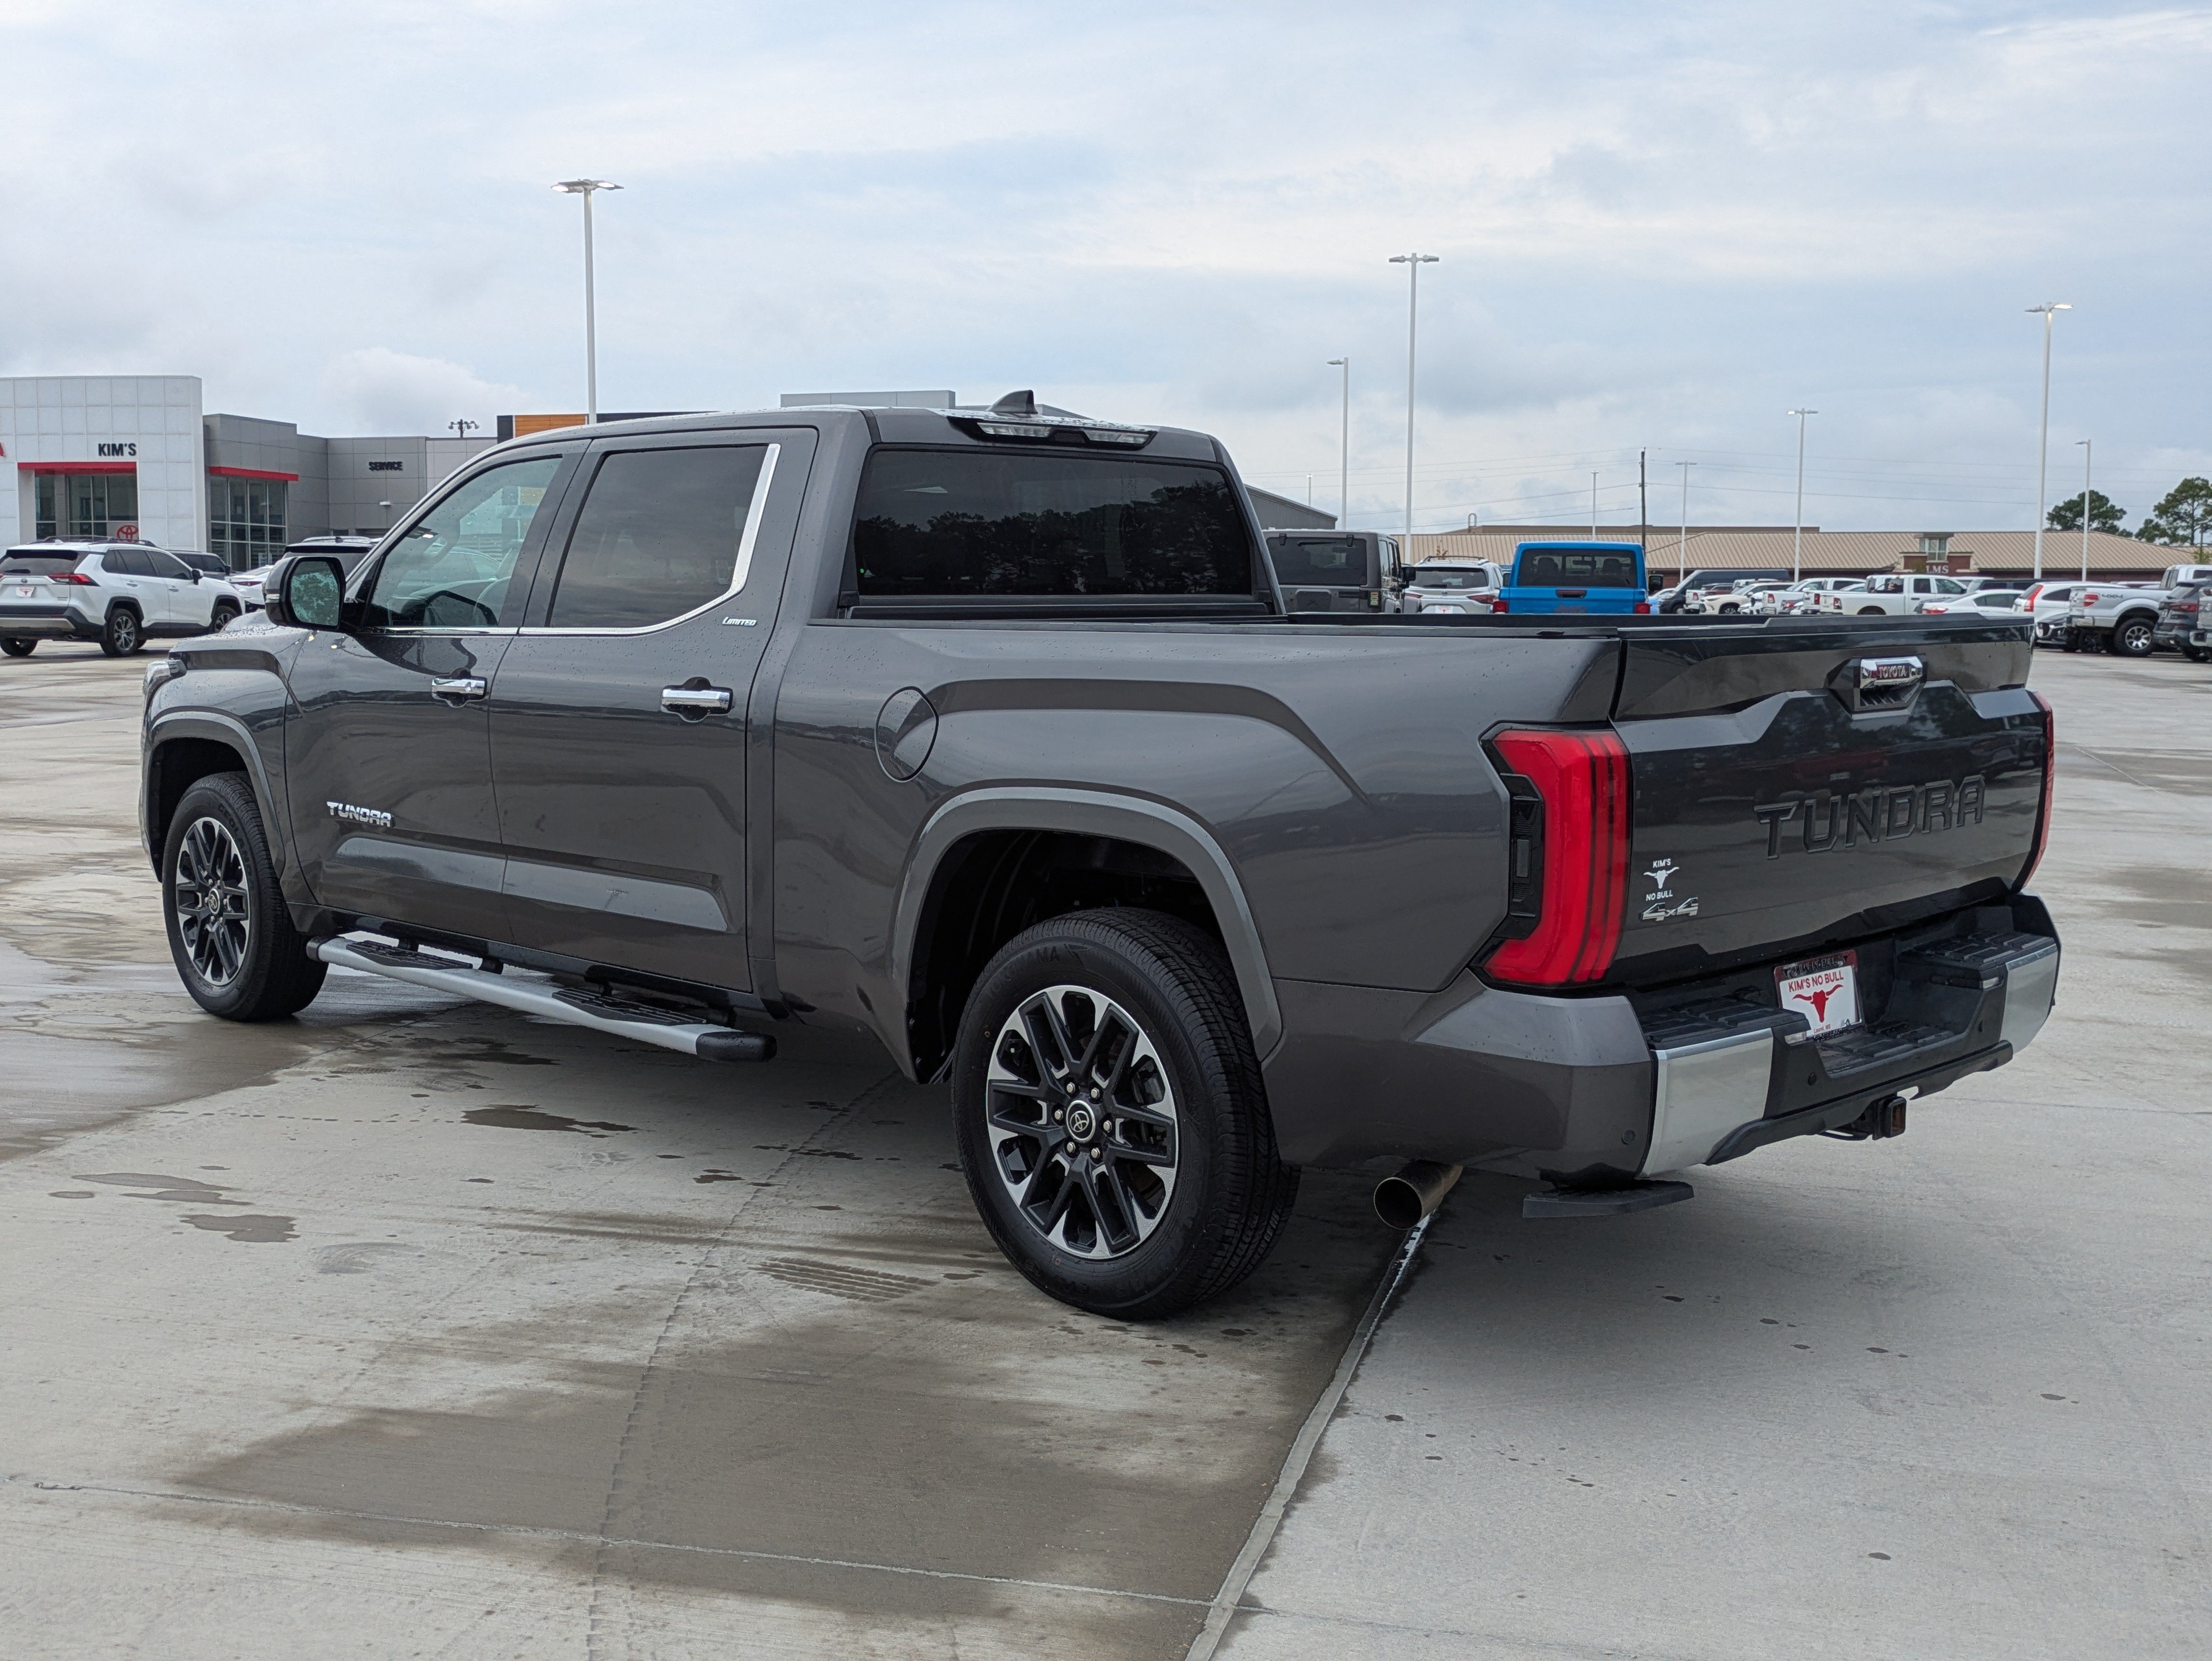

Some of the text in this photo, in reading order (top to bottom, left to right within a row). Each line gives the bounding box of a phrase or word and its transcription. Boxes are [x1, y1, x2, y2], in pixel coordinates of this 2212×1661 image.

[98, 443, 136, 456] KIM'S
[368, 461, 403, 471] SERVICE
[1925, 565, 1949, 574] LMS
[1878, 665, 1907, 678] TOYOTA
[326, 801, 394, 828] TUNDRA
[1753, 774, 1986, 860] TUNDRA
[1652, 858, 1671, 868] KIM'S
[1645, 889, 1673, 901] NO BULL
[1788, 970, 1844, 993] KIM'S NO BULL
